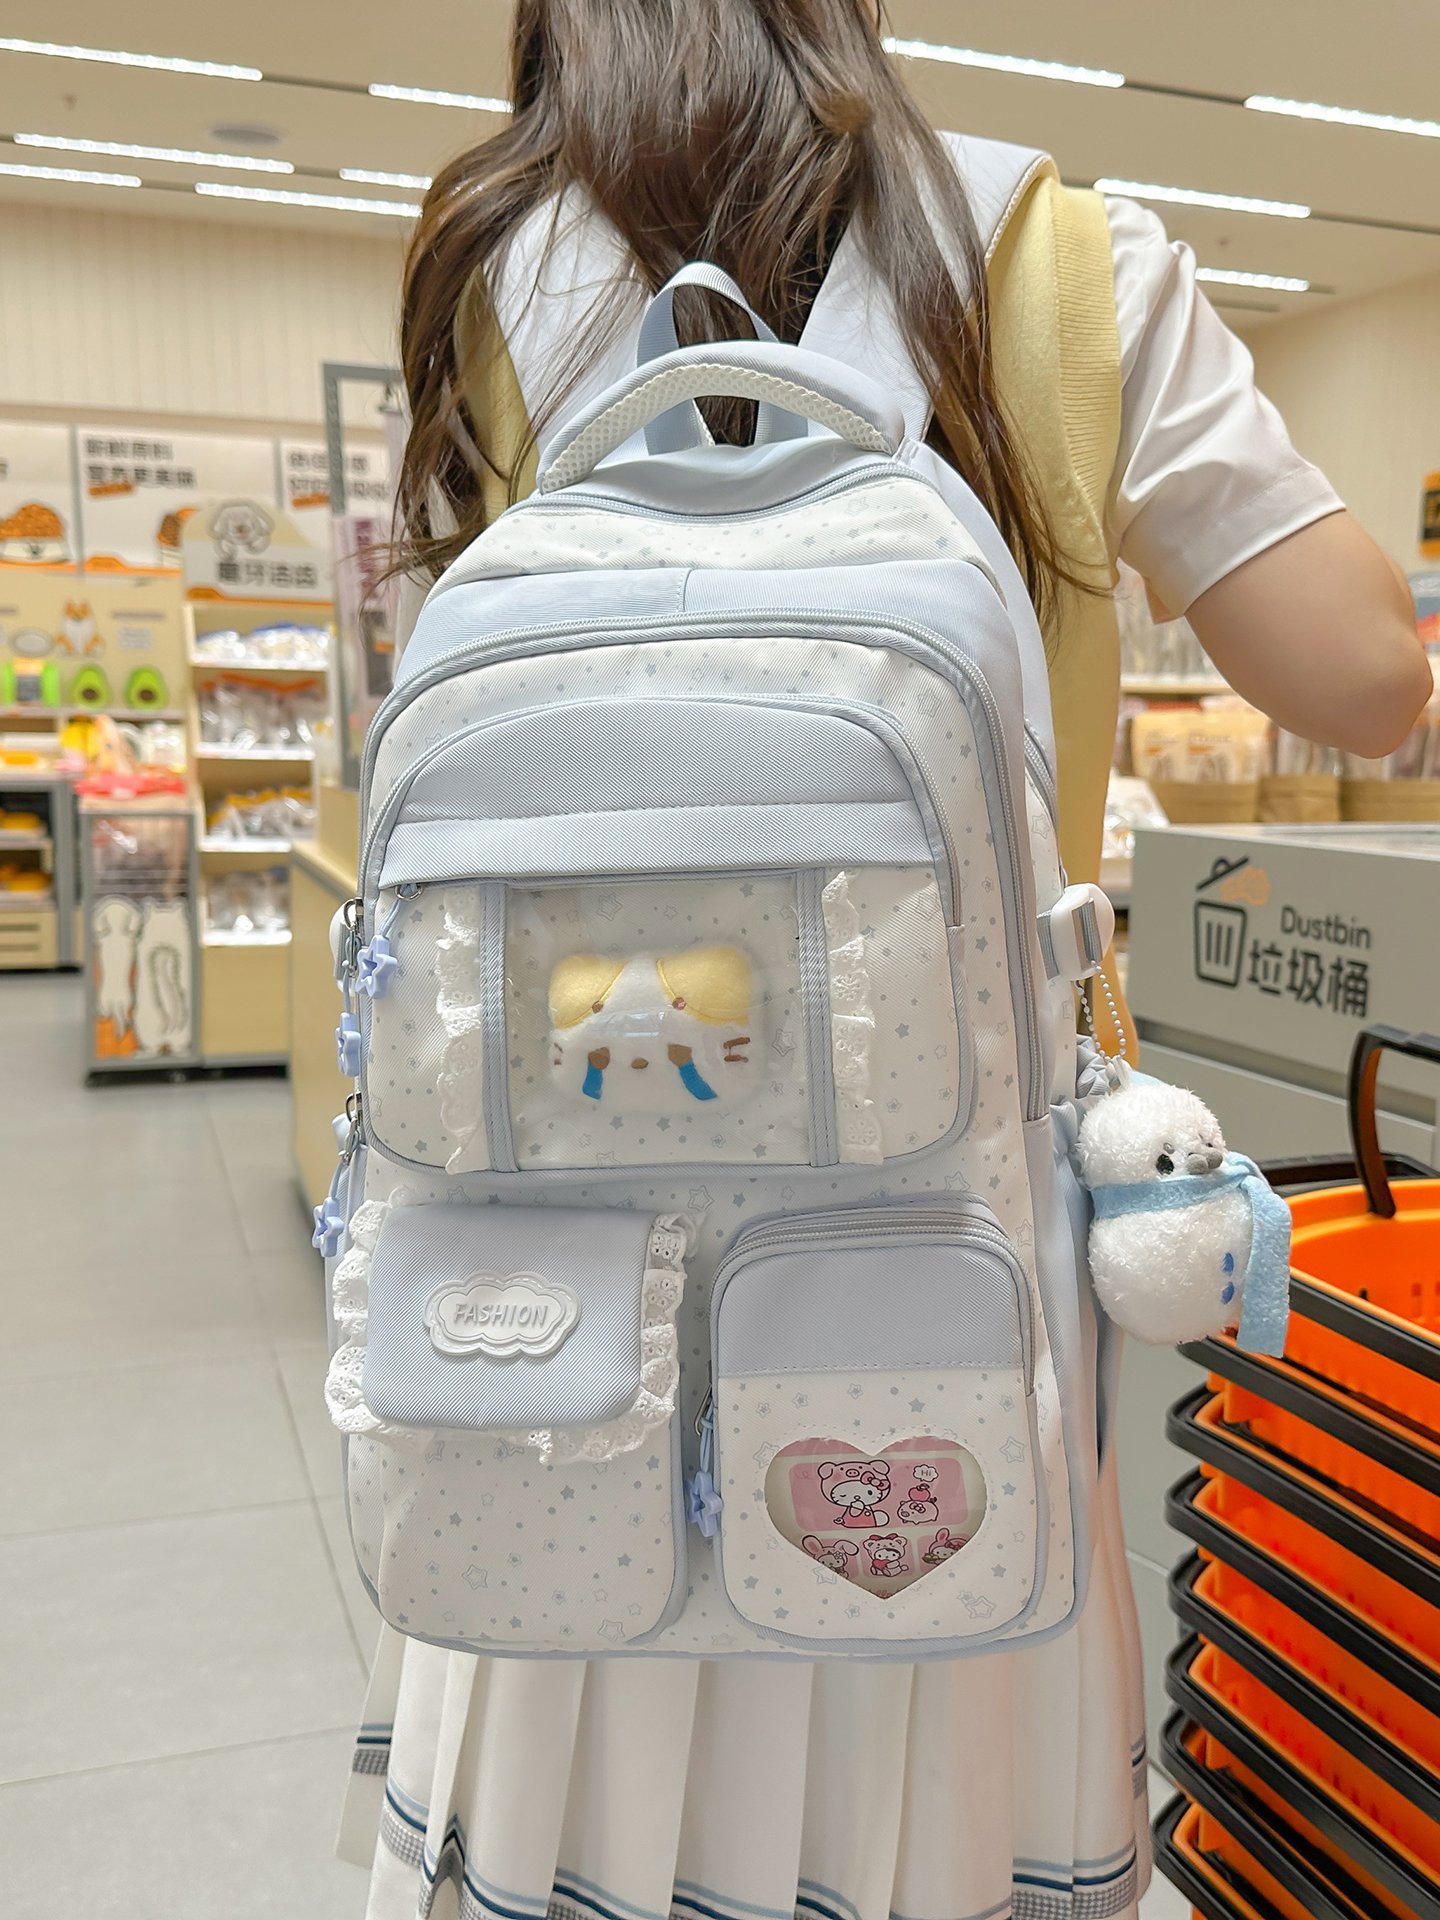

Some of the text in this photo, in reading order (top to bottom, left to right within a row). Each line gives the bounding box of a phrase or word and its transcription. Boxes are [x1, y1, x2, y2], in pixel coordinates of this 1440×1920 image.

[1281, 905, 1371, 949] Dustbin
[1247, 939, 1370, 1018] 垃圾桶
[454, 1303, 549, 1328] FASHION
[920, 1469, 932, 1477] Hi
